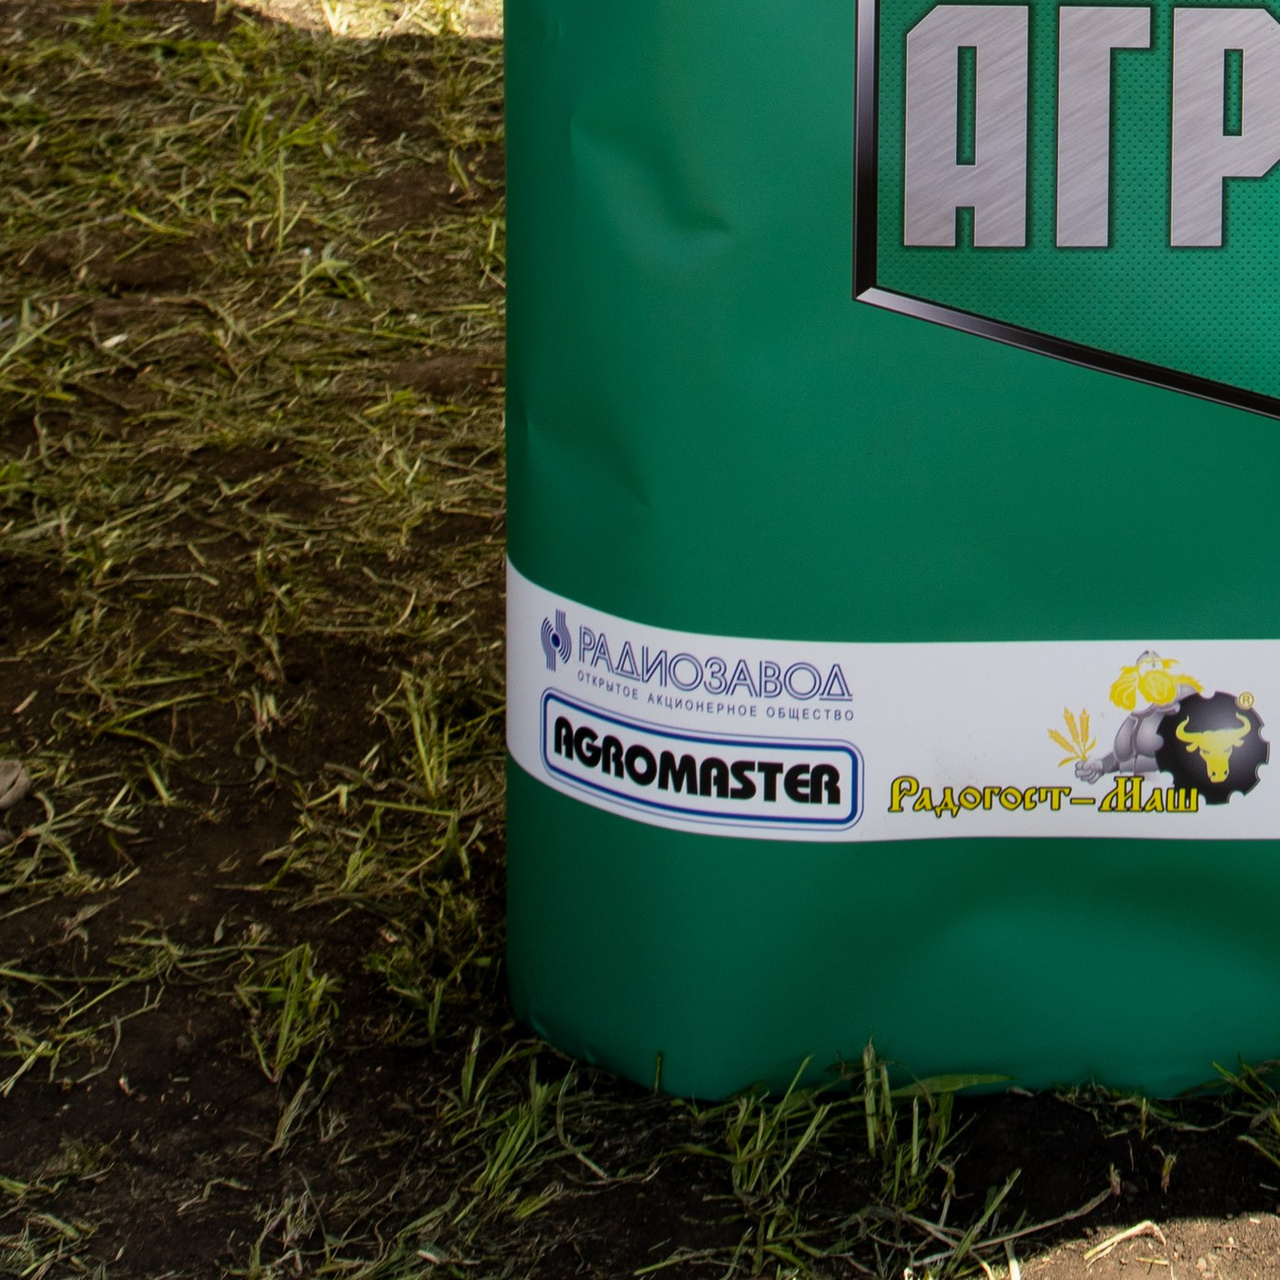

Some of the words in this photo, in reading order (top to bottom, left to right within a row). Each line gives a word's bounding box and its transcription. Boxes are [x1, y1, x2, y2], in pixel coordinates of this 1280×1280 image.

[577, 669, 639, 700] ОТКРЫТОЕ
[647, 693, 758, 718] АКЦИОНЕРНОЕ
[766, 706, 855, 722] ОБЩЕСТВО
[578, 625, 854, 701] РАДИОЗАВОД
[553, 715, 841, 806] AGROMASTER
